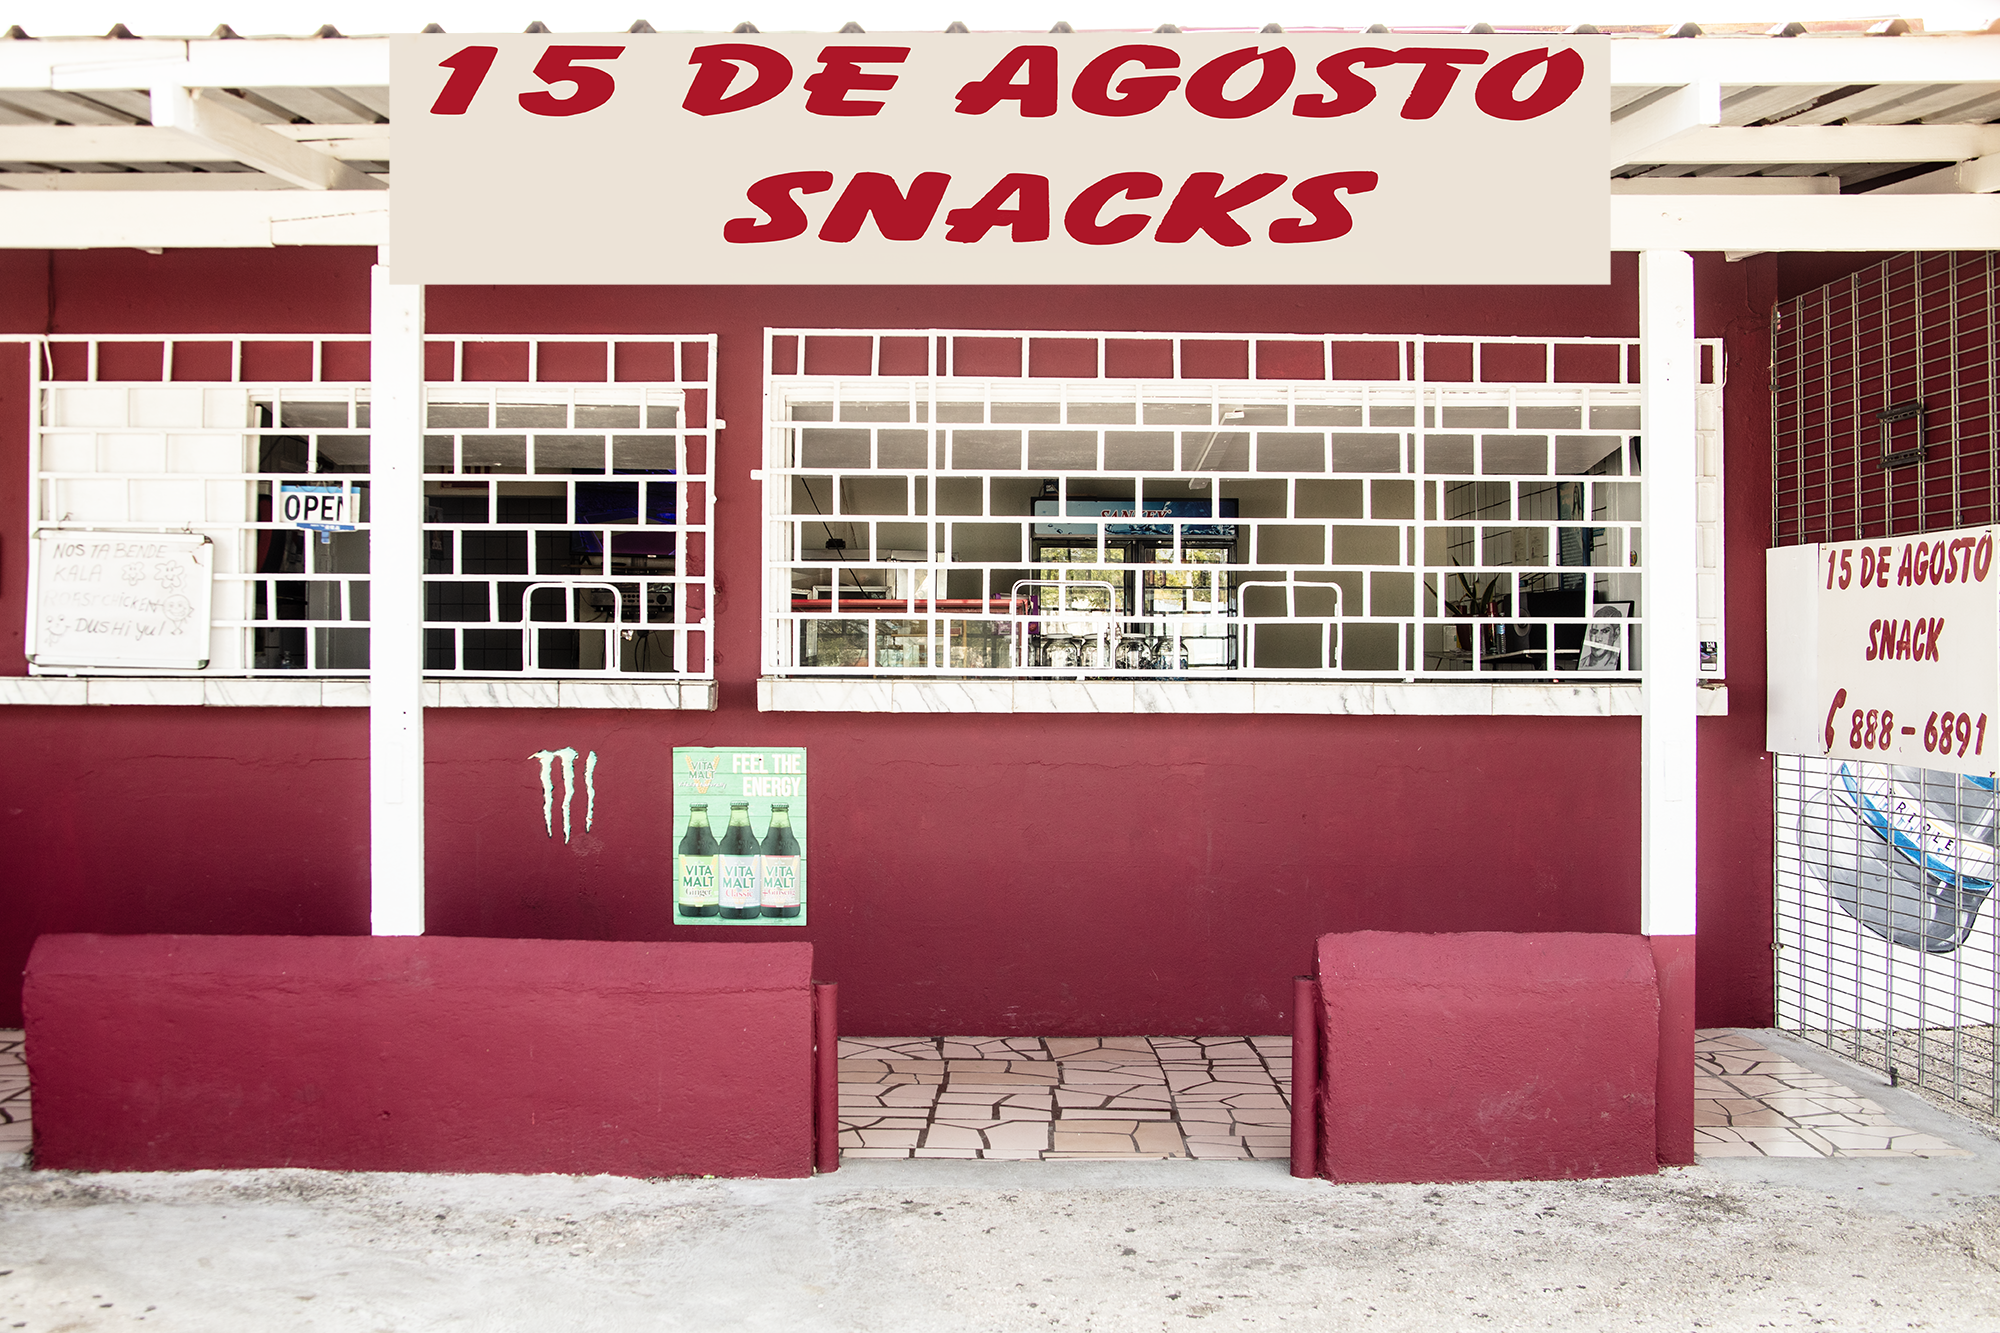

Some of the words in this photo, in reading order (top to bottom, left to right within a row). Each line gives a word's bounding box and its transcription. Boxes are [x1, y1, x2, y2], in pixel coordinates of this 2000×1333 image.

[430, 45, 626, 117] 15
[682, 43, 912, 118] DE
[955, 44, 1585, 121] AGOSTO
[723, 170, 1379, 248] SNACKS
[52, 543, 86, 559] NOS
[90, 543, 111, 560] TA
[113, 542, 168, 559] BENDE
[1827, 549, 1853, 590] 15
[1860, 546, 1892, 589] DE
[1897, 534, 1993, 587] AGOSTO
[53, 564, 103, 582] KALA
[1866, 617, 1945, 662] SNACK
[691, 761, 713, 770] VITA
[732, 753, 768, 774] FEEL
[771, 753, 802, 775] THE
[689, 771, 715, 779] MALT
[742, 776, 802, 797] ENERGY
[686, 865, 713, 876] VITA
[725, 866, 754, 877] VITA
[766, 866, 794, 877] VITA
[683, 876, 714, 887] MALT
[723, 877, 755, 889] MALT
[764, 877, 795, 888] MALT
